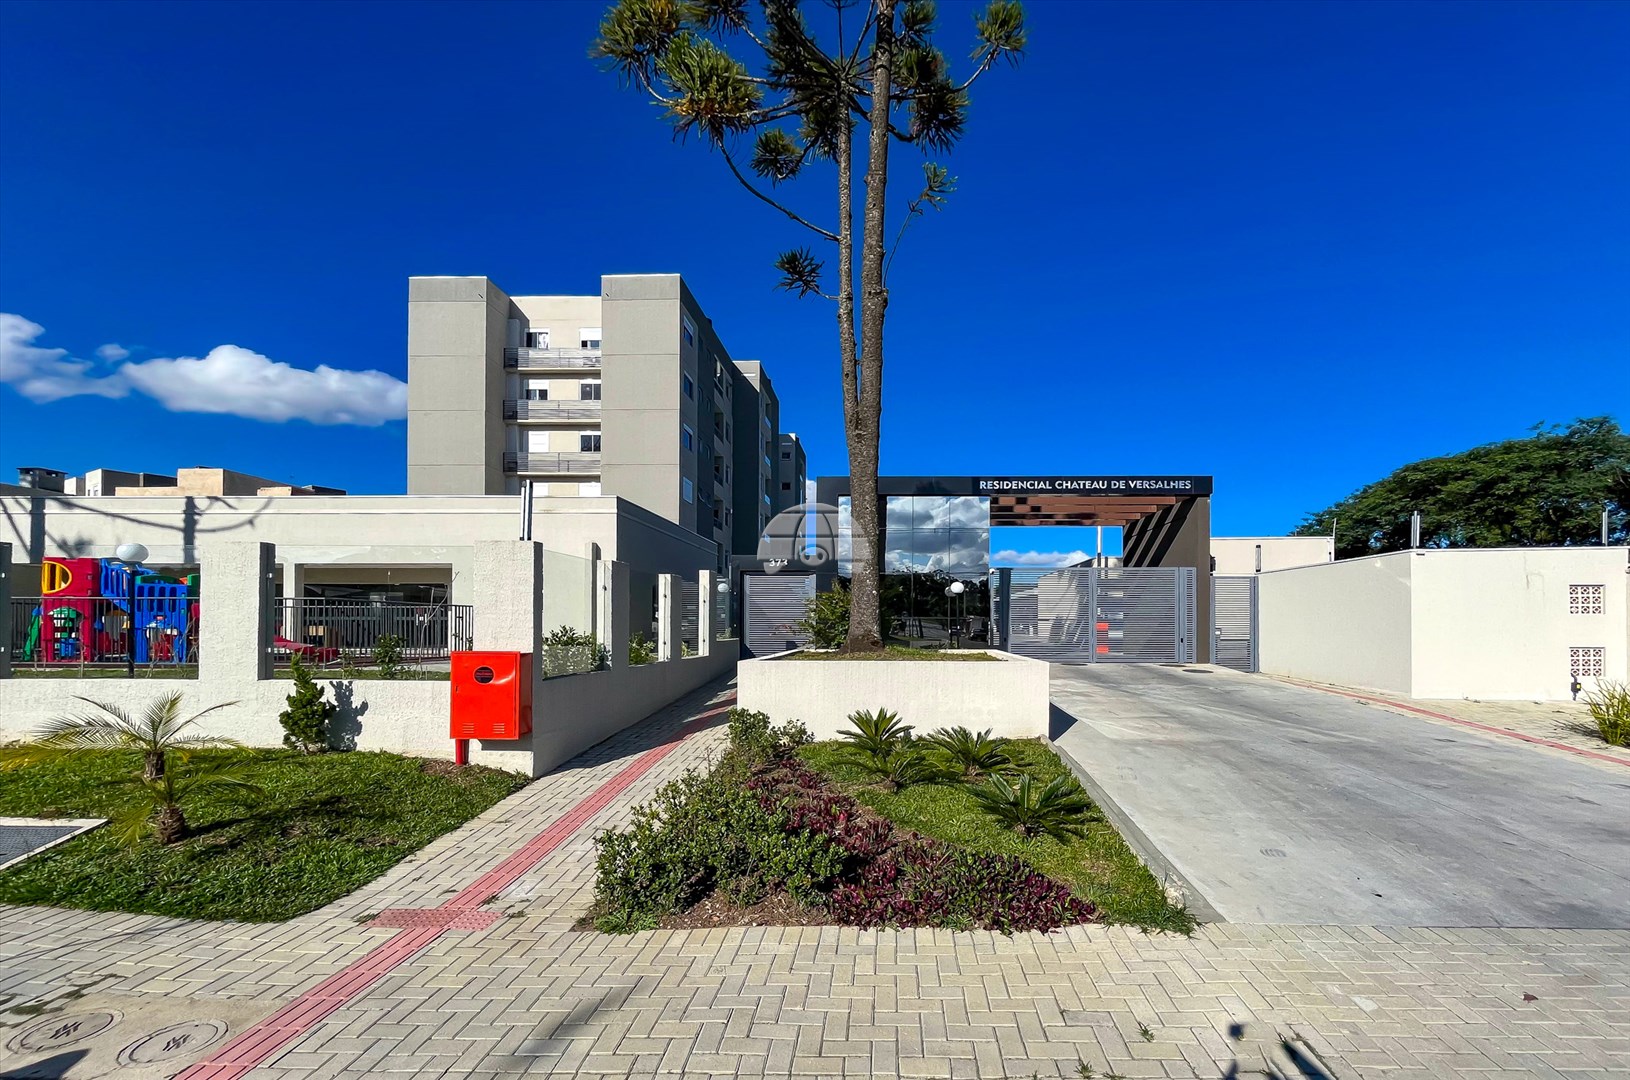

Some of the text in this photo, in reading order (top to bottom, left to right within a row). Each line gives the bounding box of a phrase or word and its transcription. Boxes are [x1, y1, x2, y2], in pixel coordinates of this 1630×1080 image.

[979, 480, 1192, 490] RESIDENCIAL CHATEAU DE VERSALHES
